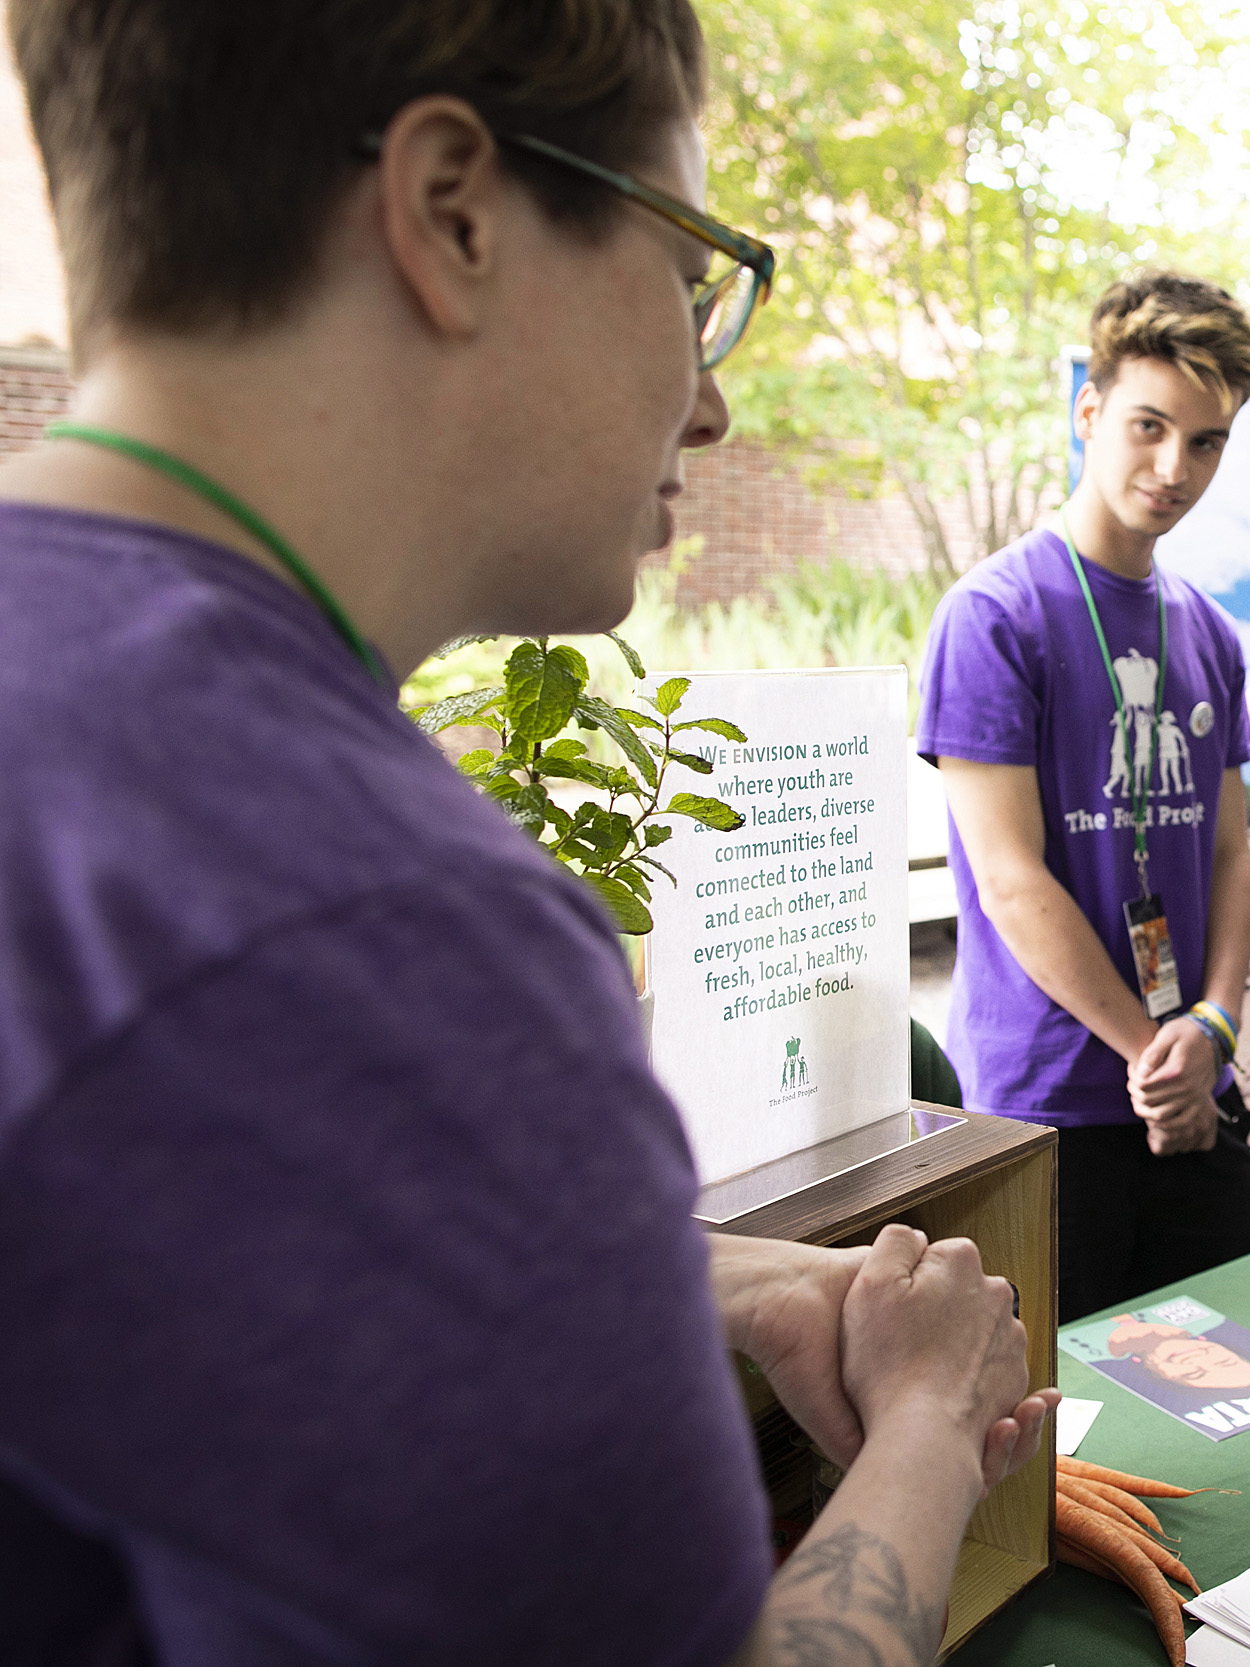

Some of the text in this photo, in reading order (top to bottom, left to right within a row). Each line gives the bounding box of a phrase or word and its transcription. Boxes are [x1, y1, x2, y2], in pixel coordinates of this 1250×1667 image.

[733, 744, 807, 764] ENVISION
[812, 743, 822, 759] a
[826, 735, 869, 757] world
[718, 768, 853, 798] where youth are
[752, 803, 816, 826] leaders,
[821, 798, 875, 818] diverse
[1064, 809, 1107, 834] The
[715, 825, 858, 863] communities feel
[695, 852, 873, 898] connected to the land
[705, 881, 867, 929] and each other, and
[694, 911, 877, 963] everyone has access to
[705, 942, 868, 993] fresh, local, healthy,
[723, 972, 854, 1021] affordable food.
[769, 1085, 818, 1107] The Food Project
